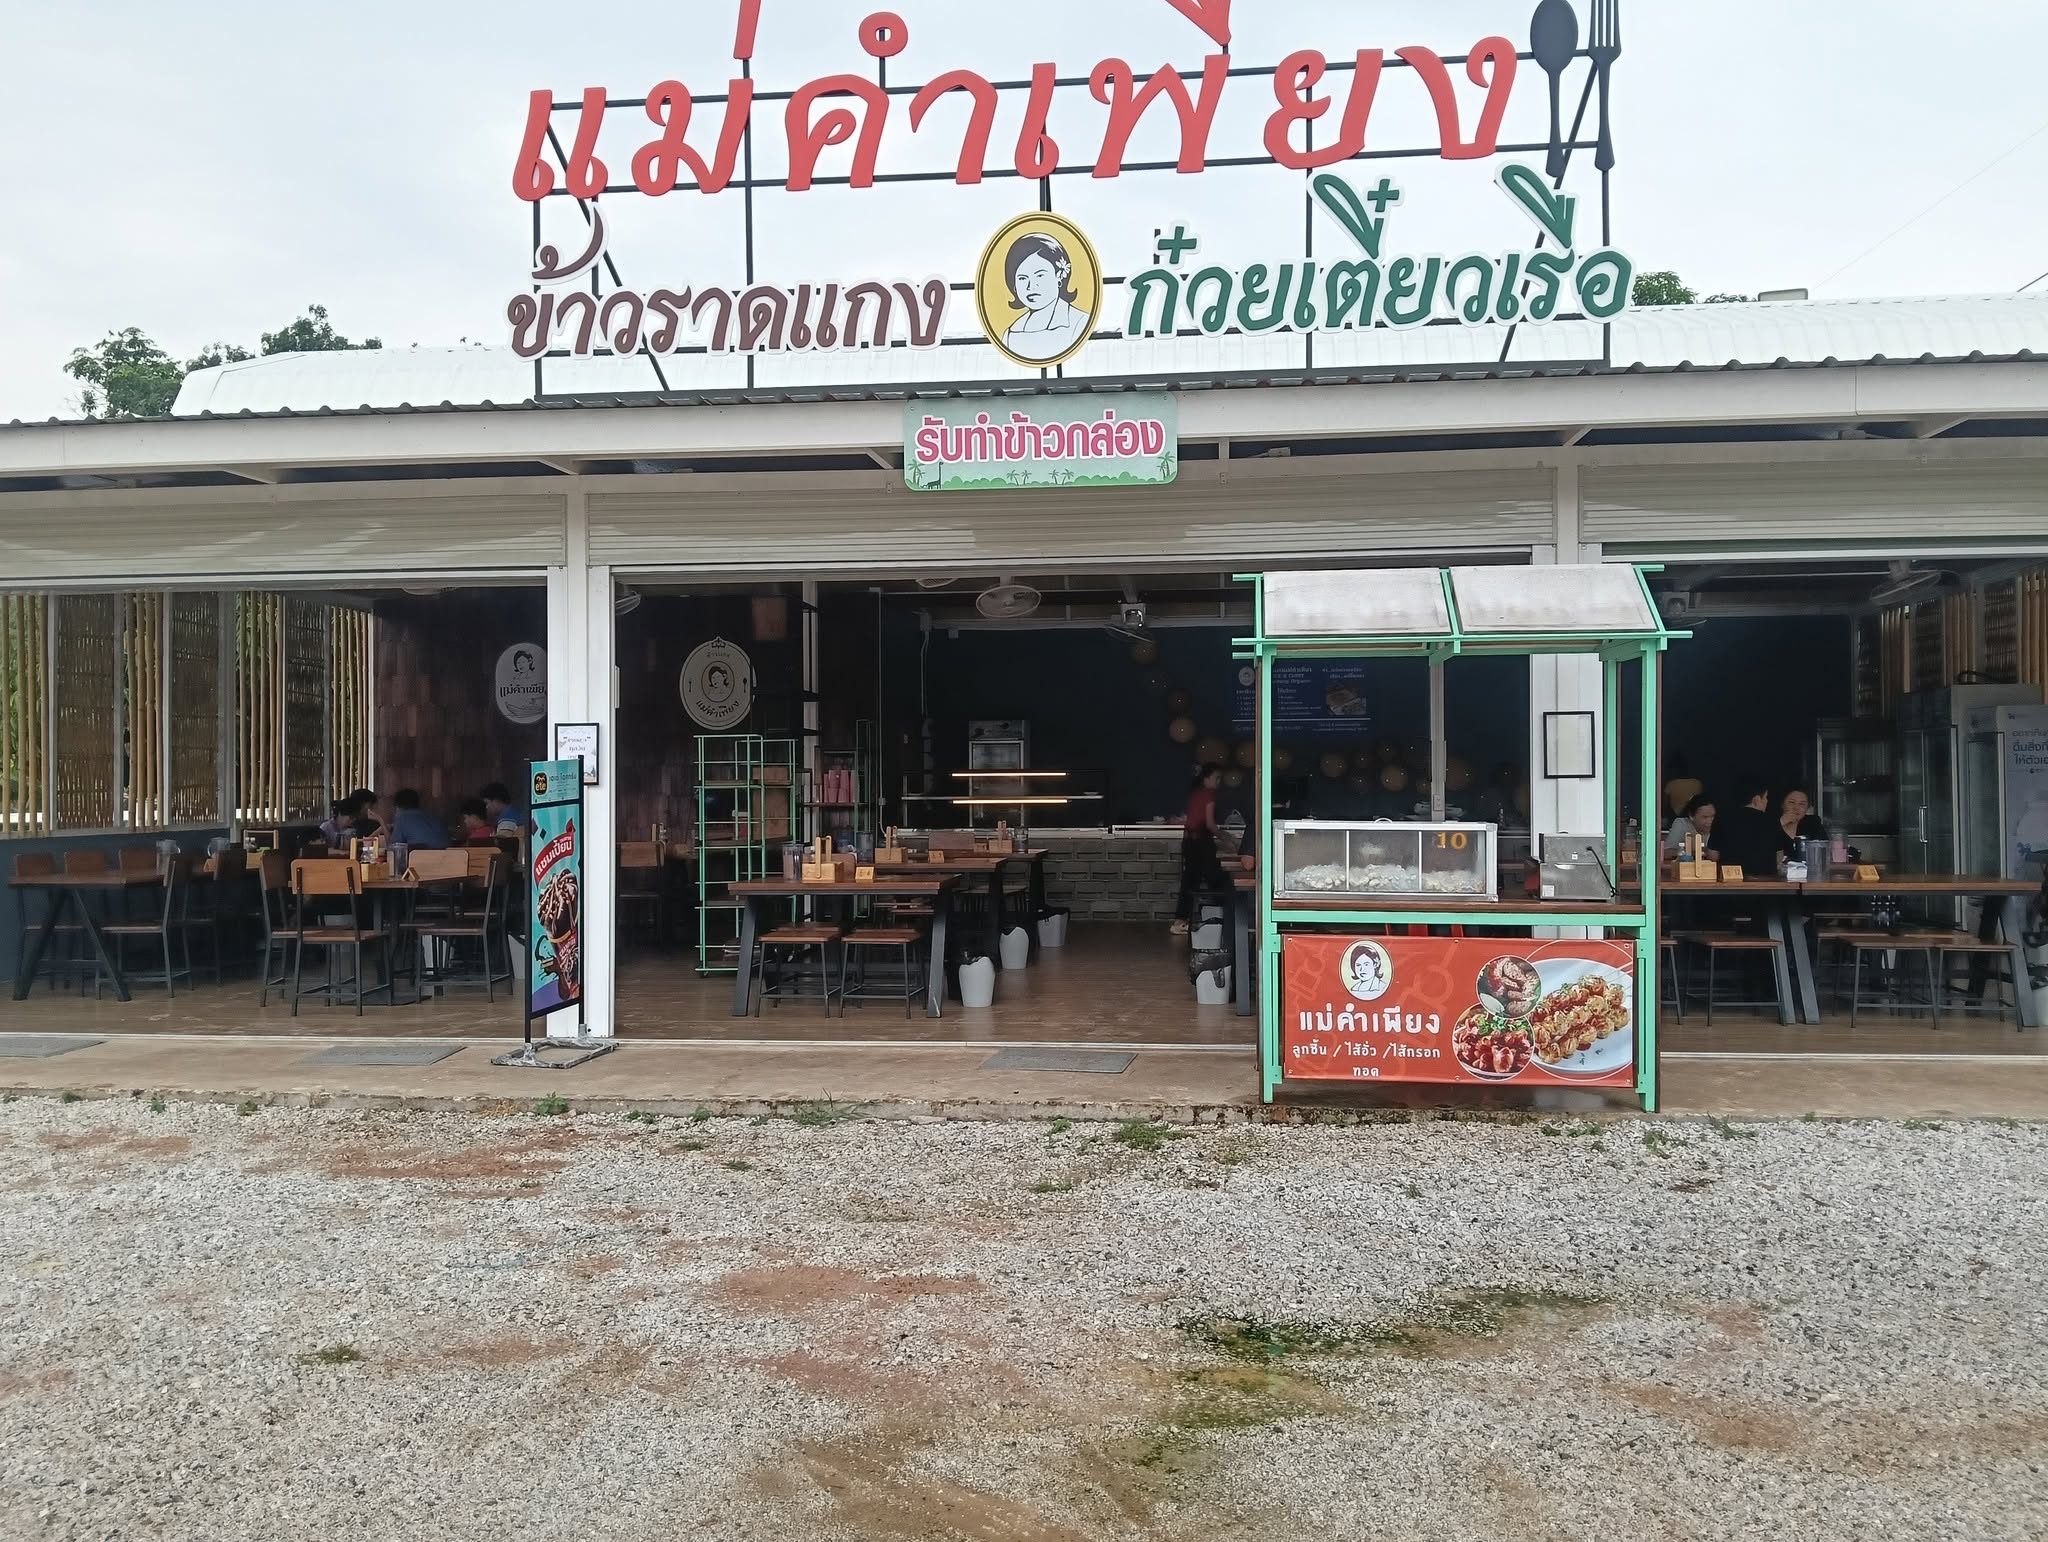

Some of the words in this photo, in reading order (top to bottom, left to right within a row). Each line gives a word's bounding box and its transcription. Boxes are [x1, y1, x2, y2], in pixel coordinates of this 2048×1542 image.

[506, 204, 948, 357] ข้าวราดแกง
[916, 410, 1165, 463] รับทำข้าวกล่อง
[499, 683, 546, 698] แม่คำเพีย
[1299, 1003, 1441, 1034] แม่คำเพียง
[1292, 1039, 1328, 1059] ลูกชิ้น
[1344, 1040, 1377, 1057] ไส้อั่ว
[1352, 1066, 1380, 1078] ทอด
